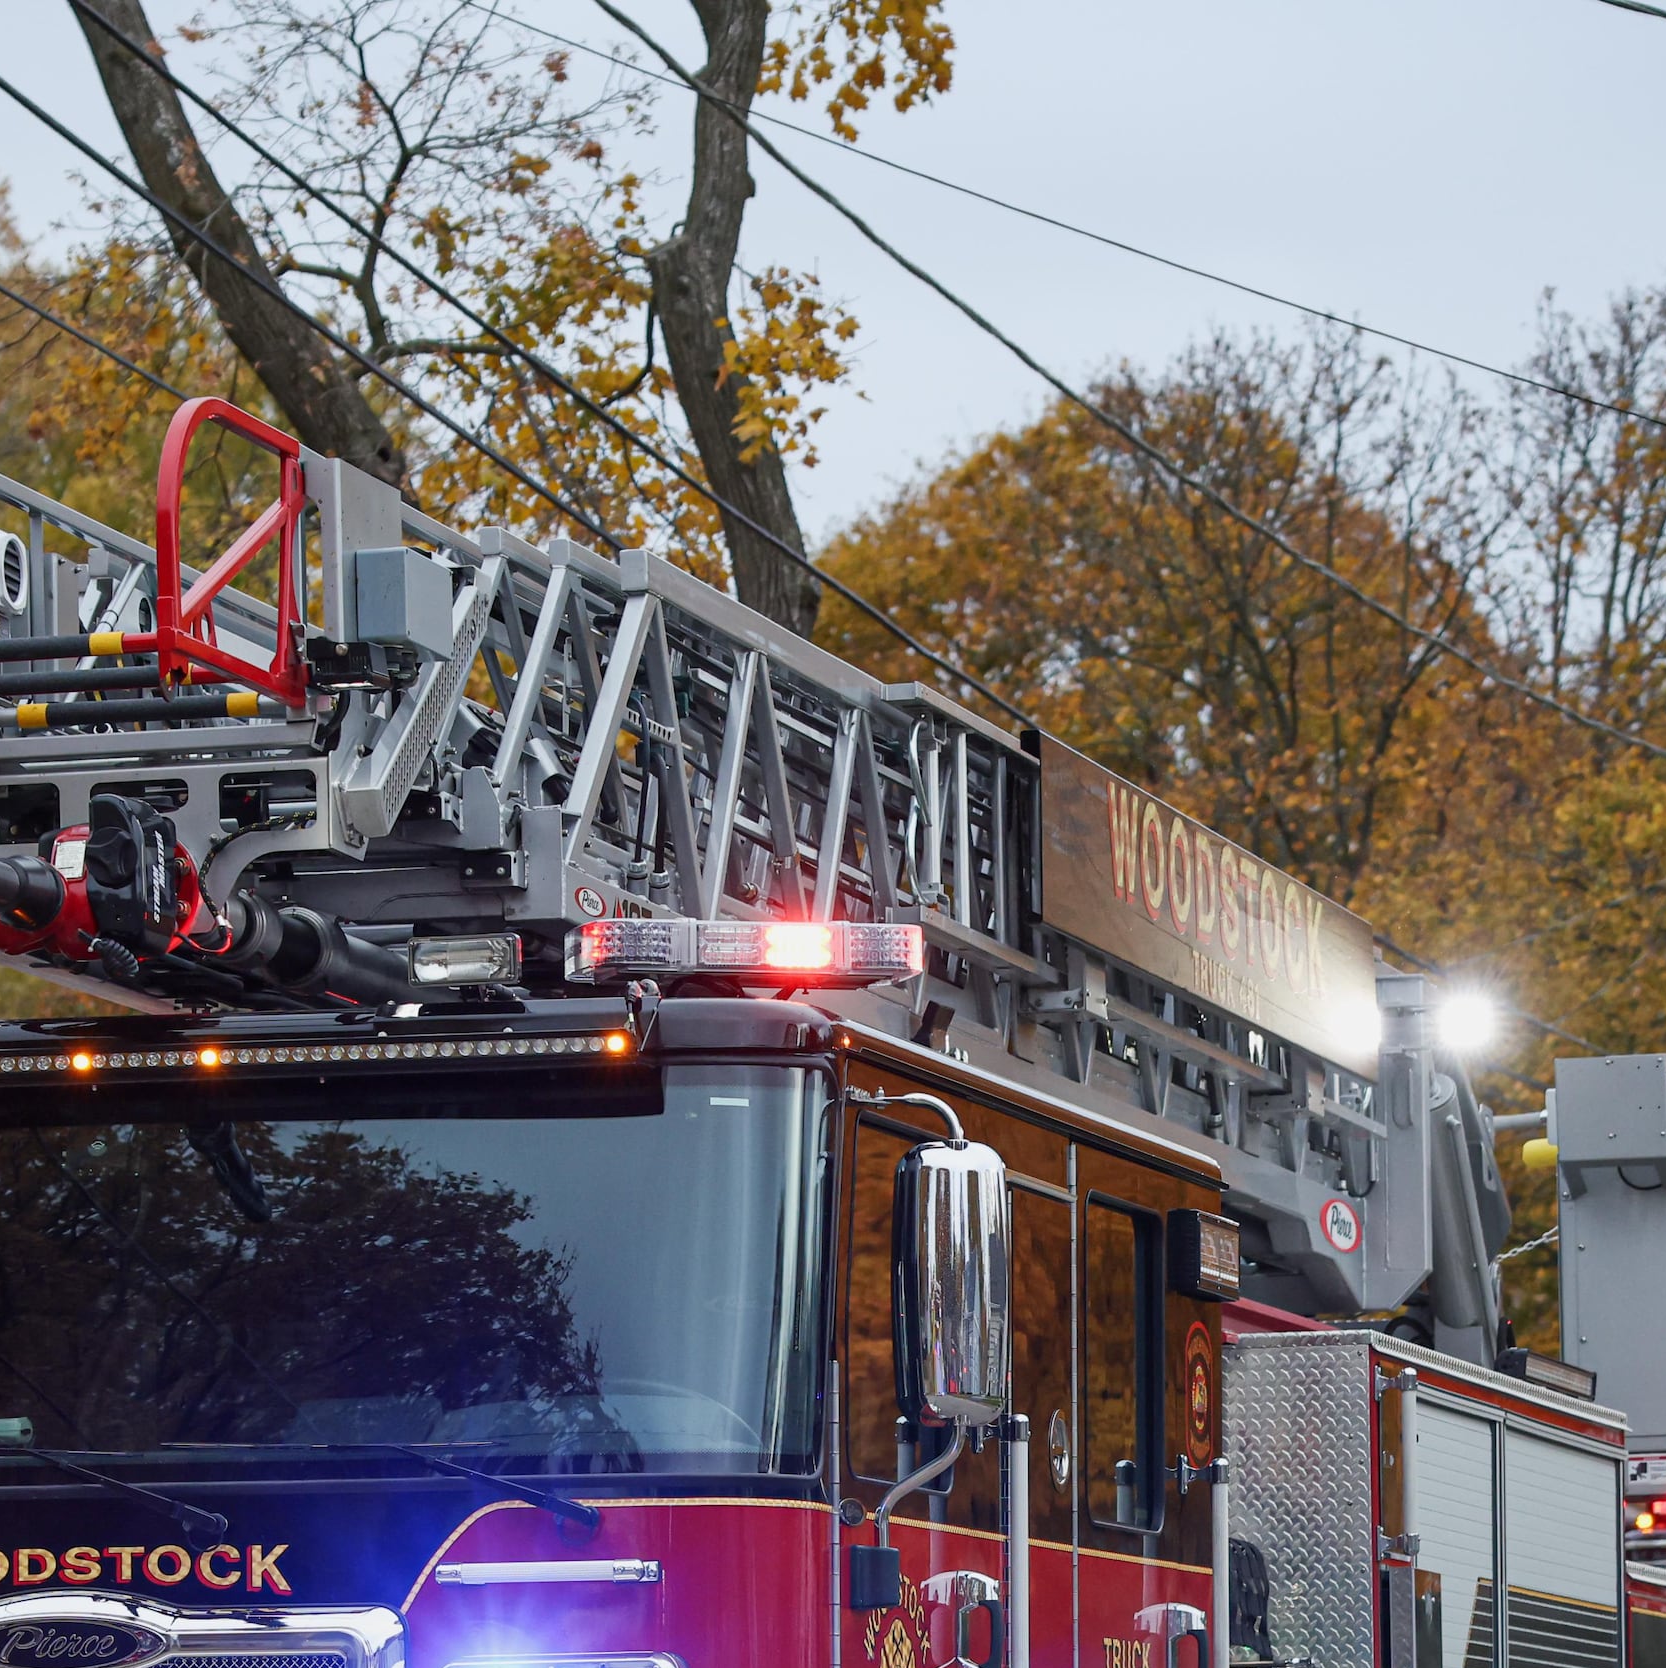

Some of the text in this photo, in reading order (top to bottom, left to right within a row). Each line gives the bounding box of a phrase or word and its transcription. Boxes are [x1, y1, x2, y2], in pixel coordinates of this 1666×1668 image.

[153, 865, 162, 924] STREAM
[581, 889, 600, 912] Pierce
[1107, 781, 1323, 996] WOODSTOCK
[1192, 949, 1235, 1009] TRUCK
[1330, 1205, 1352, 1240] Pierce
